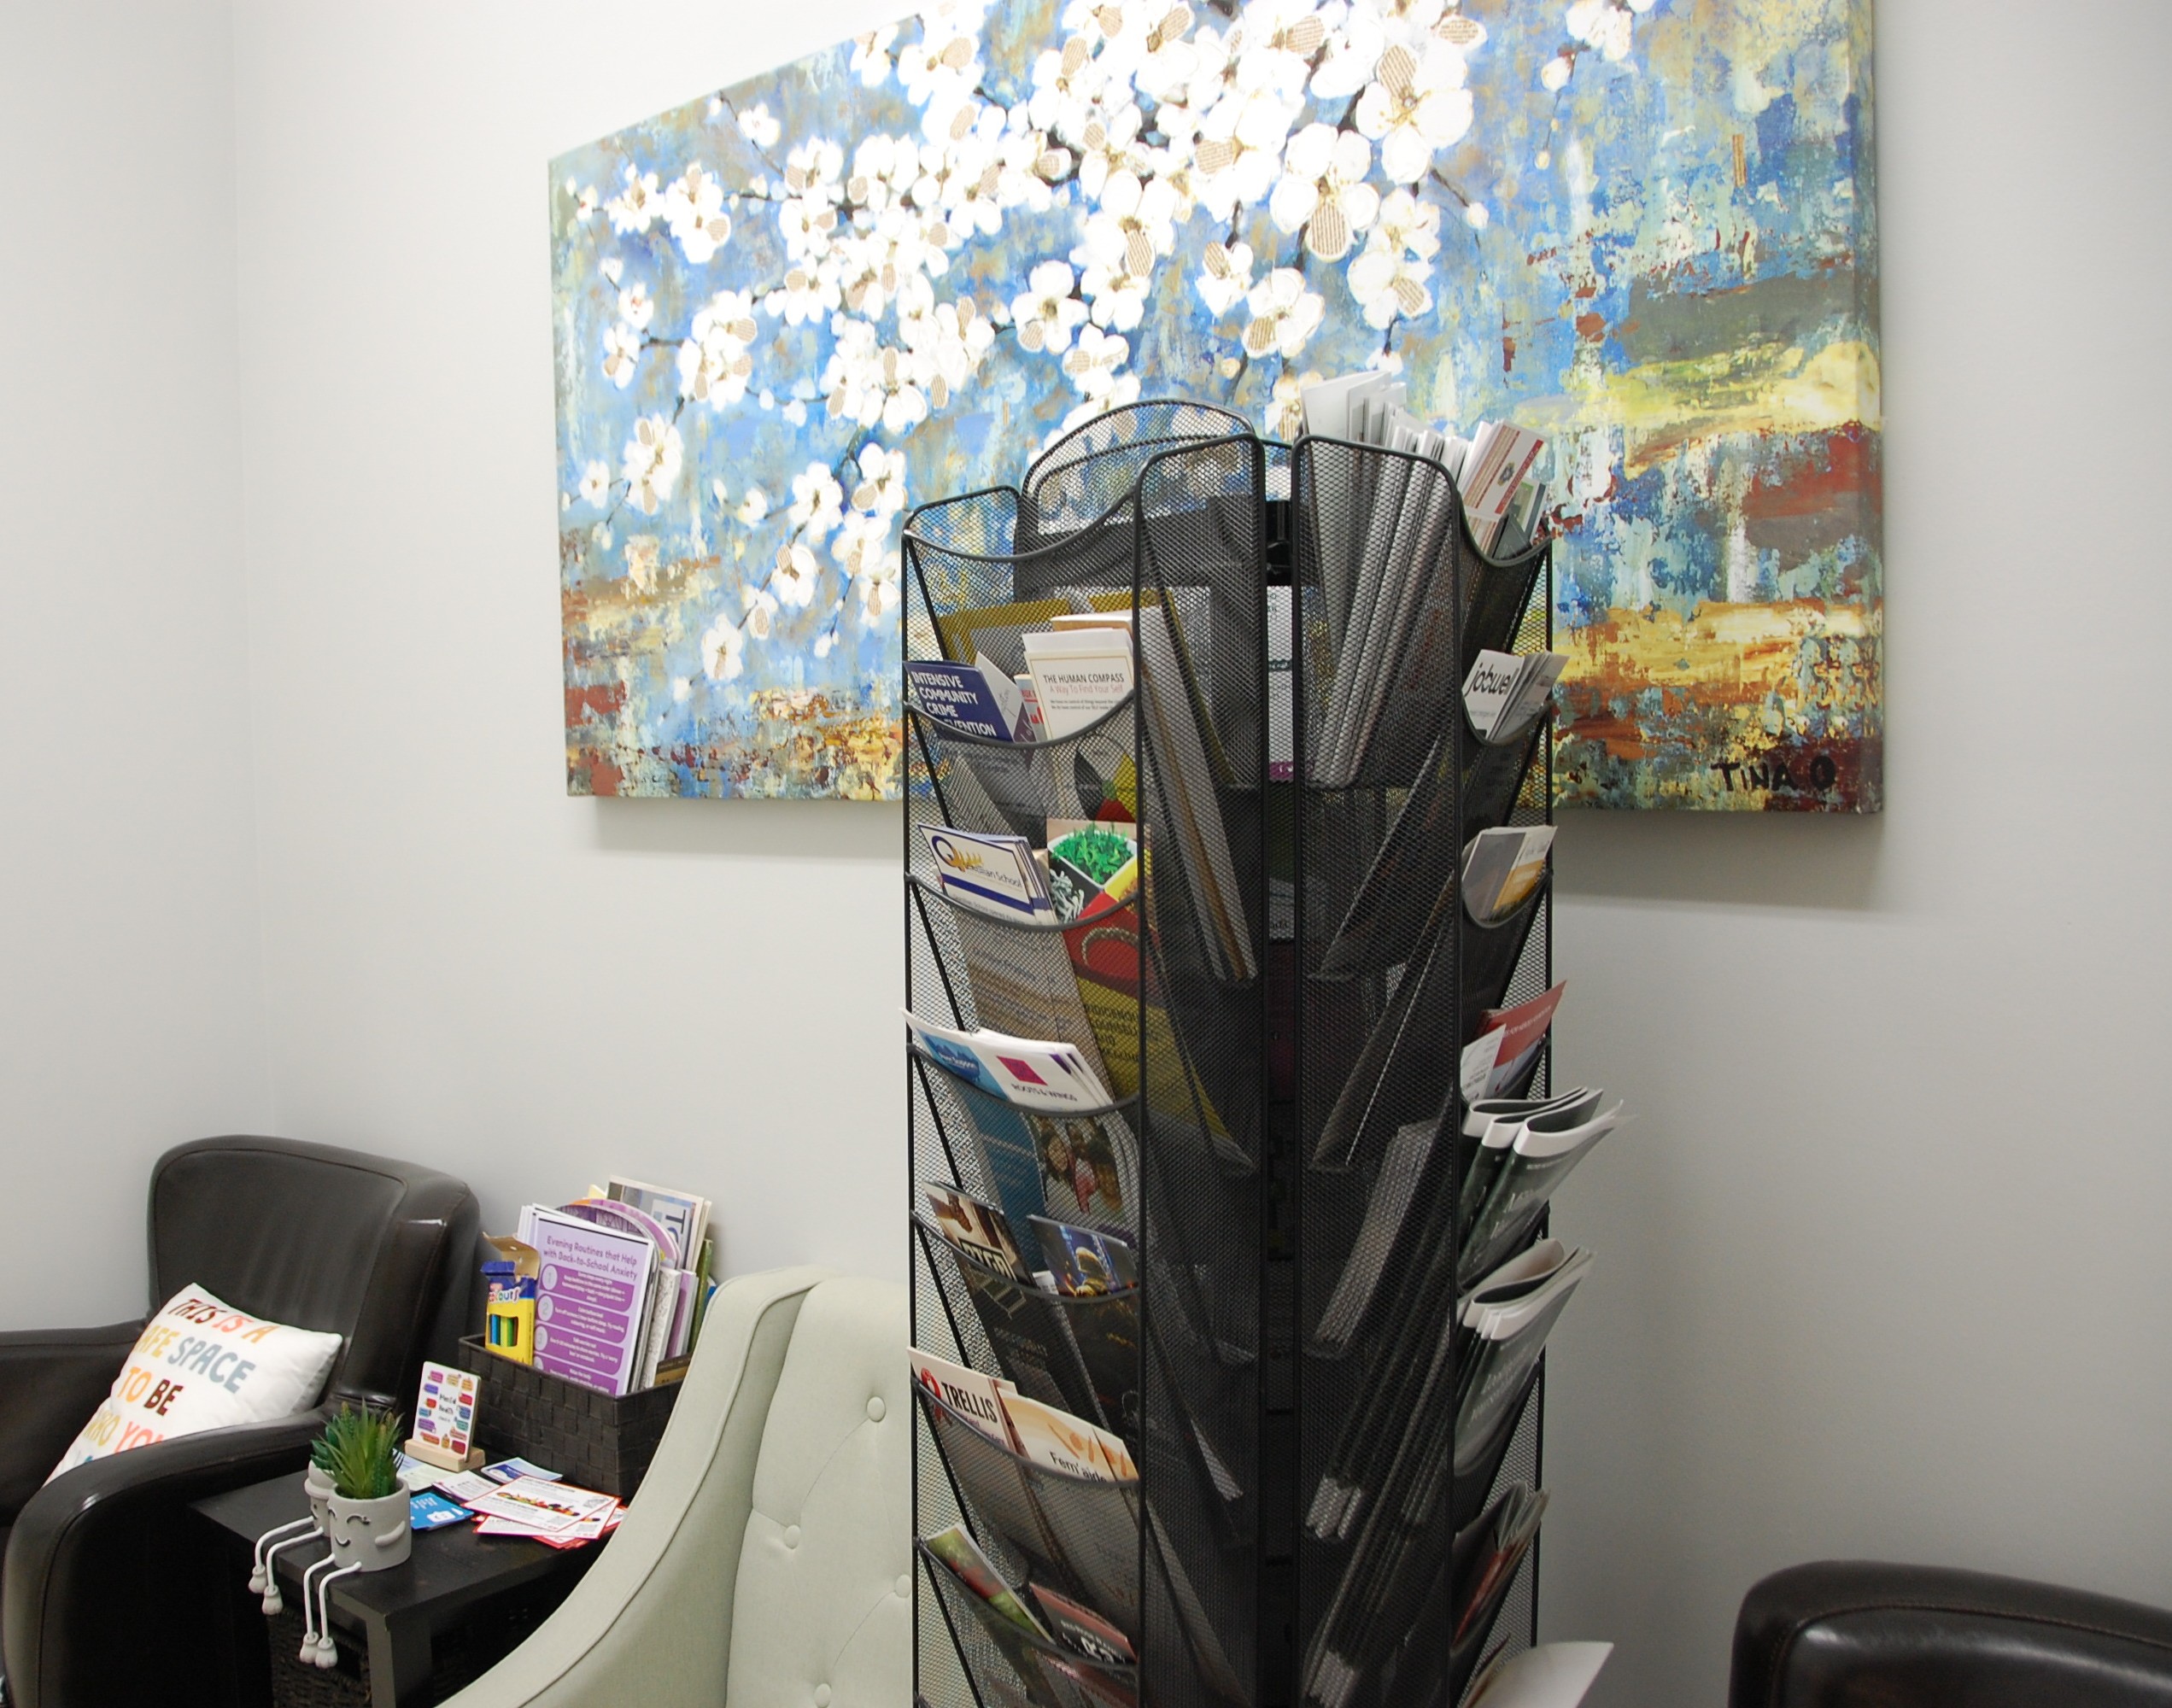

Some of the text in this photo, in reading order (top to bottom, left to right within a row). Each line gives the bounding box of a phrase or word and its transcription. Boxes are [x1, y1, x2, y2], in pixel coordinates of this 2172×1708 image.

[911, 671, 963, 688] INTENSIVE
[1043, 673, 1125, 684] THE HUMAN COMPASS
[1057, 686, 1068, 696] Way
[1069, 685, 1079, 693] To
[1079, 685, 1094, 693] Find
[1094, 685, 1109, 693] Your
[919, 687, 979, 705] COMMUNITY
[926, 702, 958, 717] CRIME
[1710, 755, 1836, 792] TINA O
[543, 1249, 557, 1258] with
[558, 1251, 610, 1272] Back-to-School
[610, 1265, 638, 1281] Anxiety
[547, 1235, 637, 1266] Evening Routines that Help
[167, 1298, 280, 1343] THIS IS A
[135, 1325, 256, 1394] AFE SPACE
[117, 1366, 184, 1416] TO BE
[941, 1381, 998, 1424] TRELLIS
[114, 1421, 164, 1454] YO
